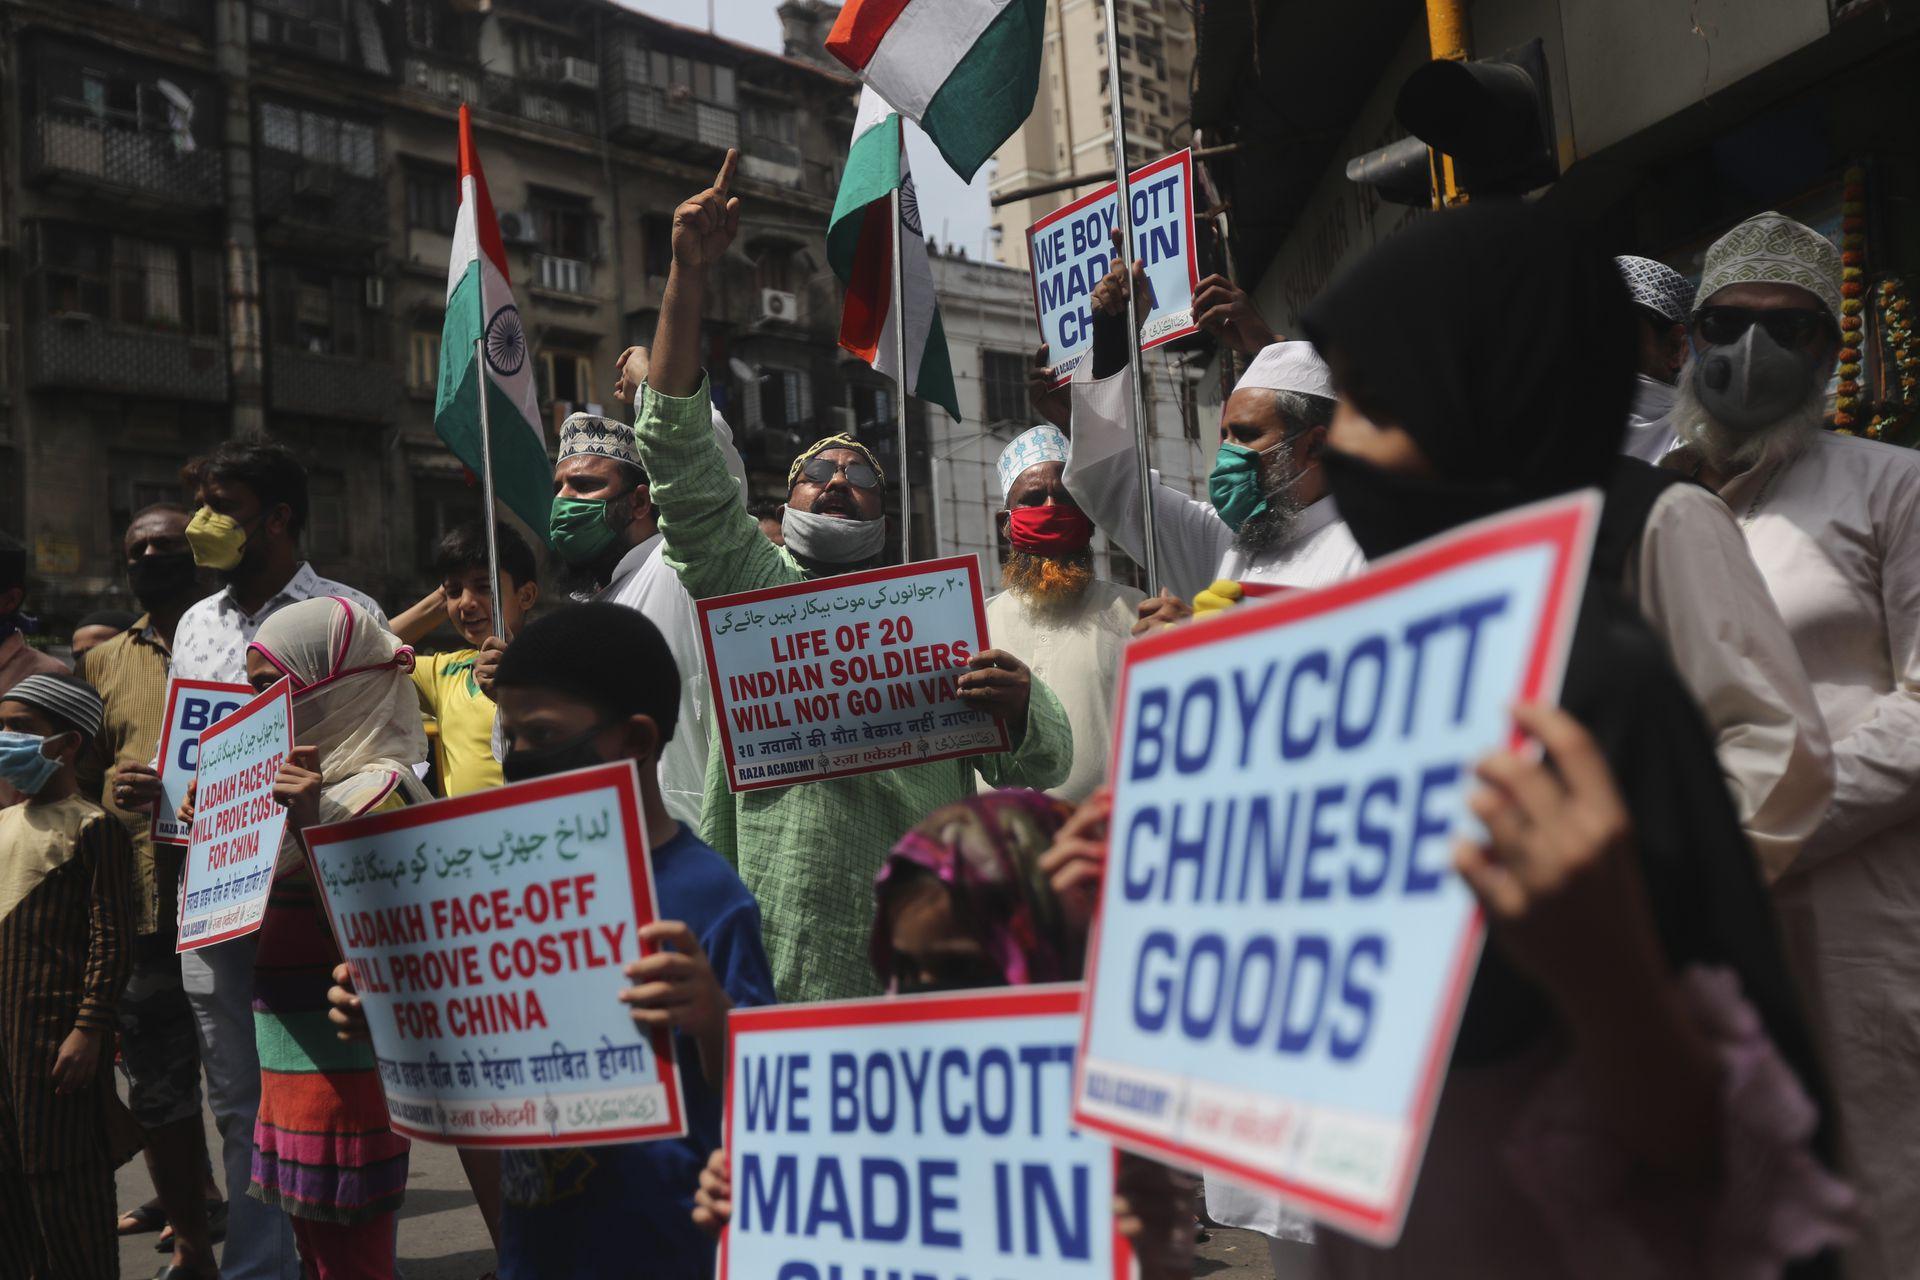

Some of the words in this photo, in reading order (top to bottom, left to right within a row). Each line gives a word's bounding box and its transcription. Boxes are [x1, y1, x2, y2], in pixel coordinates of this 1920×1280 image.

[1034, 227, 1067, 275] WE
[1071, 174, 1179, 258] BOYOTT
[1039, 246, 1118, 316] MAD
[1139, 219, 1180, 269] IN
[768, 604, 797, 626] نہیں
[801, 600, 831, 620] بیکار
[833, 594, 865, 613] موت
[868, 586, 887, 610] کی
[889, 581, 937, 605] جوانوں
[770, 629, 829, 663] LIFE
[835, 621, 870, 653] OF
[879, 615, 914, 646] 20
[728, 662, 825, 702] INDIAN
[829, 639, 971, 687] SOLDIERS
[1128, 593, 1511, 783] BOYCOTT
[731, 701, 792, 733] WILL
[793, 692, 840, 724] NOT
[846, 687, 881, 717] GO
[887, 681, 916, 711] IN
[919, 672, 962, 705] VA
[759, 731, 803, 755] जवानों
[806, 728, 827, 747] की
[830, 724, 859, 745] मौत
[862, 721, 904, 740] बेकार
[906, 710, 937, 733] नहीं
[199, 774, 237, 813] LADAKH
[238, 751, 284, 798] FACE-OFF
[738, 765, 766, 781] RAZA
[767, 758, 815, 777] ACADEMY
[192, 814, 213, 847] WILL
[215, 800, 249, 838] PROVE
[553, 809, 611, 861] لداخ
[1122, 762, 1466, 902] CHINESE
[207, 840, 227, 872] FOR
[229, 829, 260, 866] CHINA
[409, 841, 428, 884] کو
[433, 845, 473, 879] چین
[340, 902, 429, 949] LADAKH
[430, 873, 597, 940] FACE-OFF
[389, 945, 484, 994] PROVE
[488, 921, 626, 982] COSTLY
[391, 999, 443, 1041] FOR
[445, 988, 549, 1039] CHINA
[1131, 929, 1389, 1063] GOODS
[527, 1041, 590, 1083] साबित
[594, 1034, 647, 1081] होगा
[743, 1053, 811, 1134] WE
[739, 1152, 963, 1250] MADE
[993, 1160, 1092, 1262] IN
